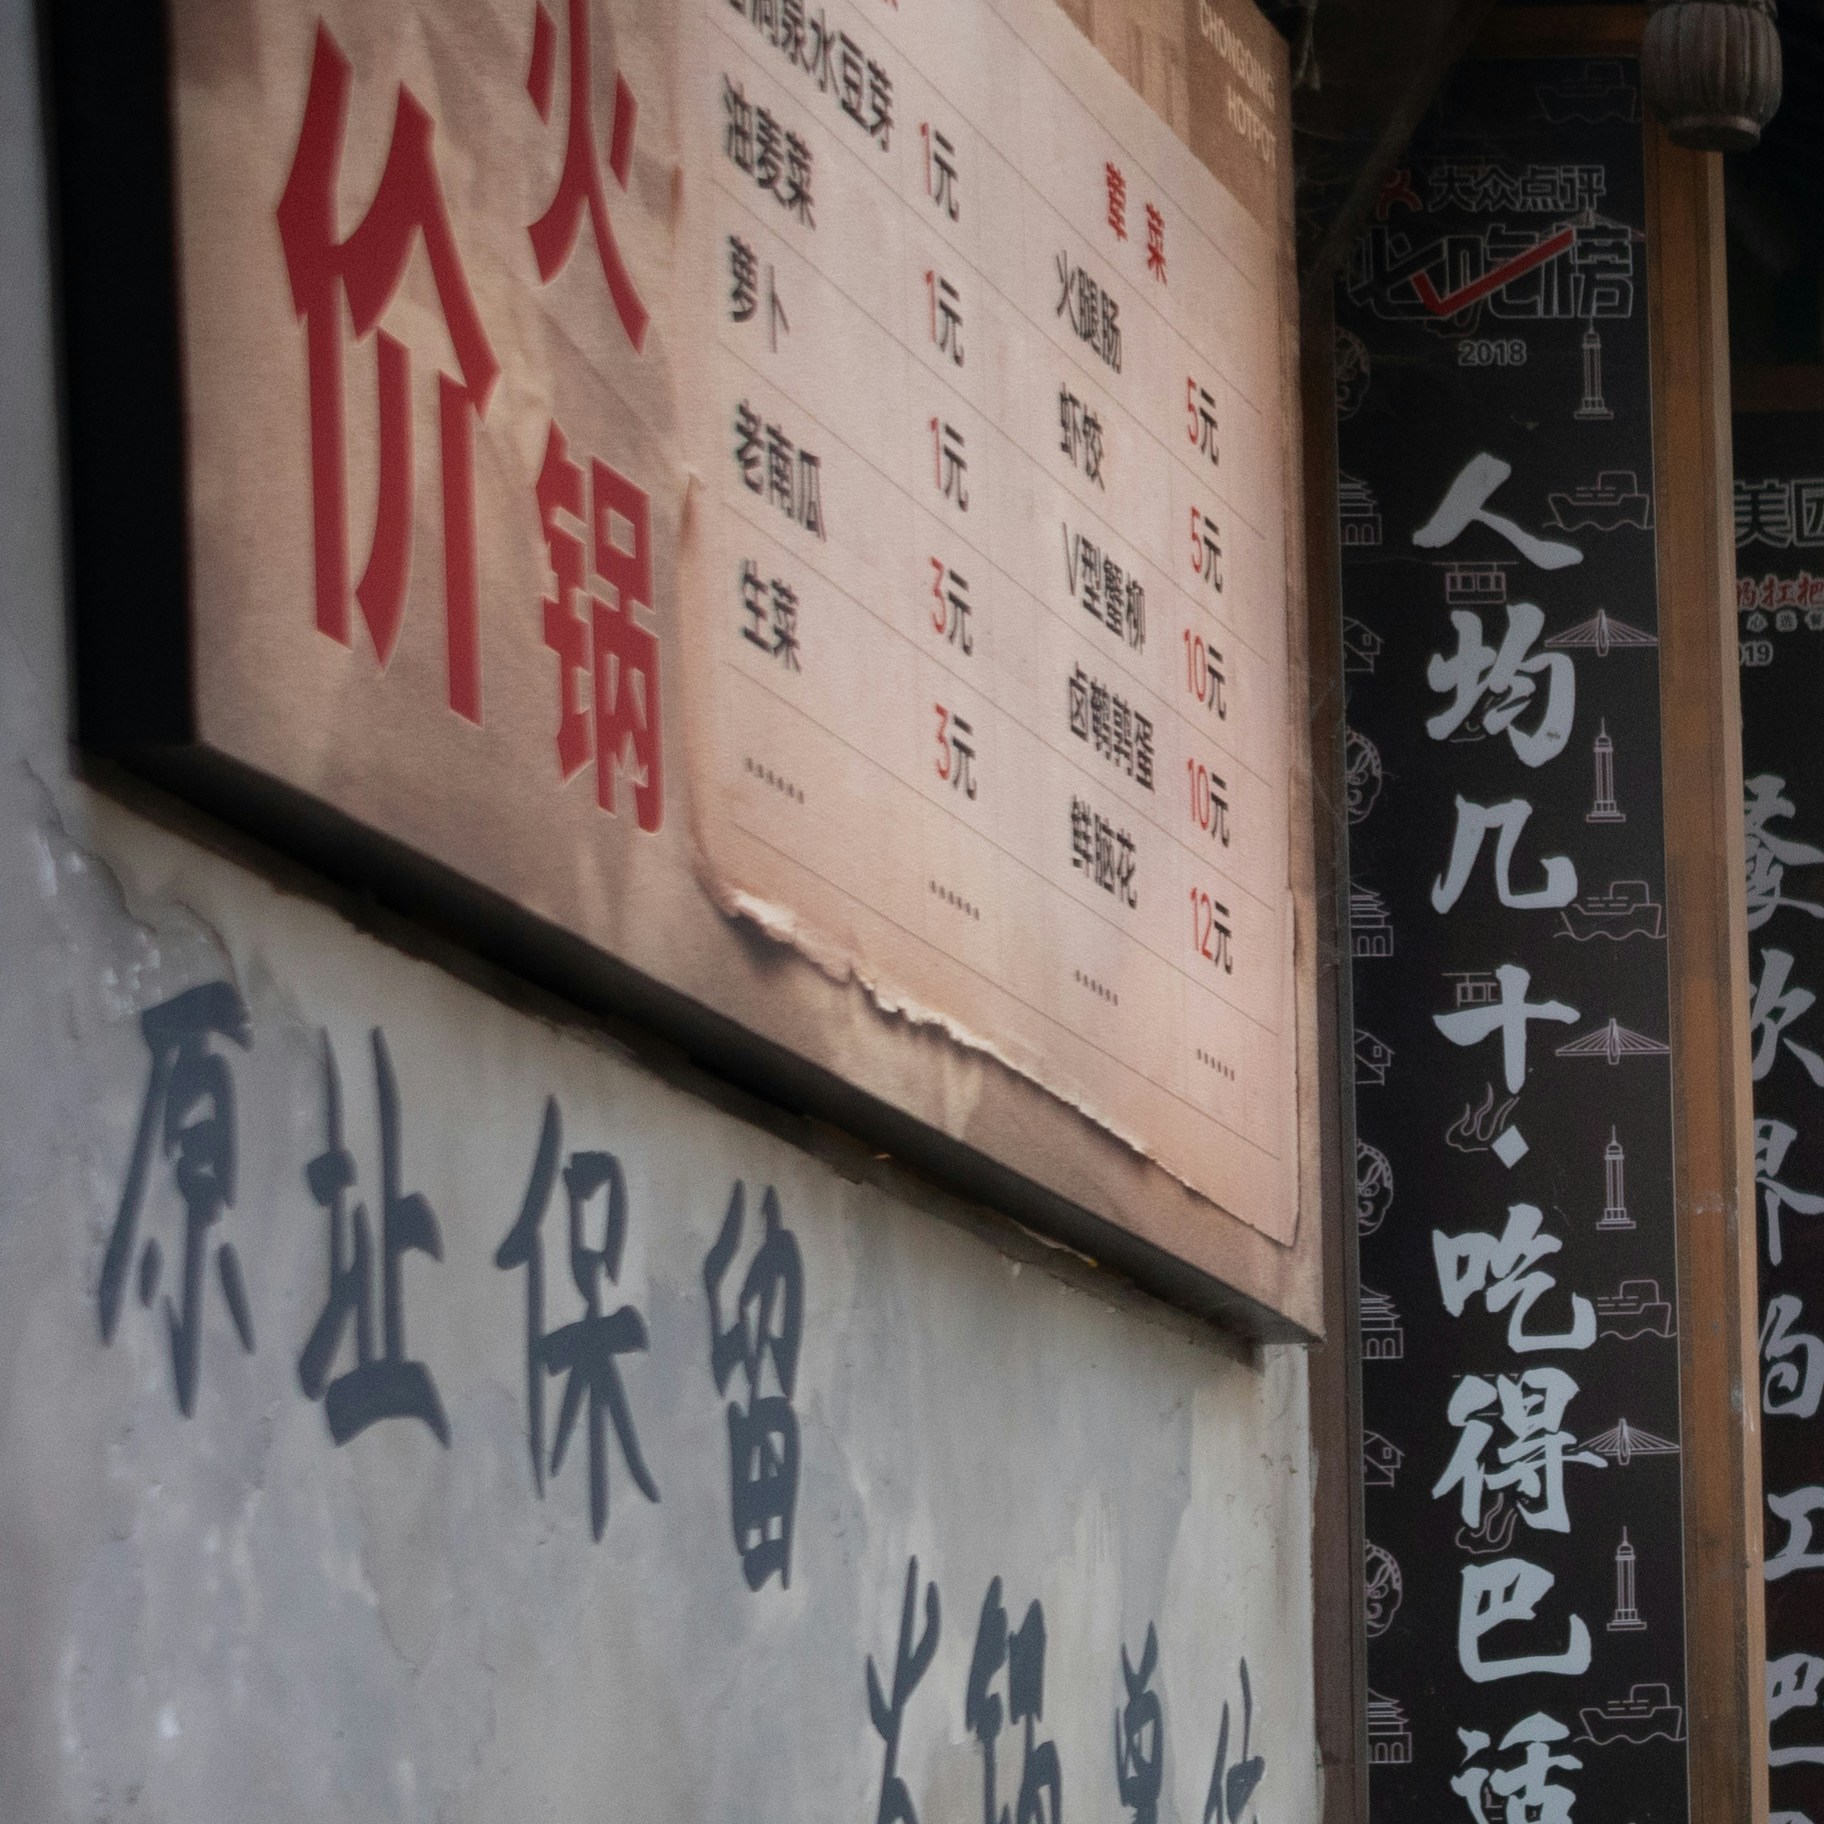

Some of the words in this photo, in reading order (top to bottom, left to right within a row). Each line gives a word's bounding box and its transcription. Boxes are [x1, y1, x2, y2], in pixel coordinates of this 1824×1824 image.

[919, 121, 960, 223] 1元
[1227, 84, 1276, 168] HOTPOT
[1428, 164, 1607, 213] 大众点评
[722, 72, 816, 231] 油麦菜
[923, 268, 964, 368] 1元
[1346, 221, 1634, 320] 必吃榜
[276, 14, 502, 728] 价
[729, 234, 790, 354] 萝卜
[929, 416, 969, 512] 1元
[1056, 249, 1122, 374] 火腿肠
[1186, 375, 1219, 466] 5元
[1458, 338, 1528, 367] 2018
[736, 398, 826, 543] 老南瓜
[930, 556, 973, 656] 3元
[1059, 382, 1105, 493] 虾饺
[1190, 506, 1223, 594] 5元
[741, 558, 801, 673] 生菜
[934, 703, 977, 801] 3元
[1183, 628, 1227, 721] 10元
[1071, 794, 1137, 910] 鲜脑花
[1190, 887, 1233, 975] 12元
[1187, 757, 1230, 848] 10元
